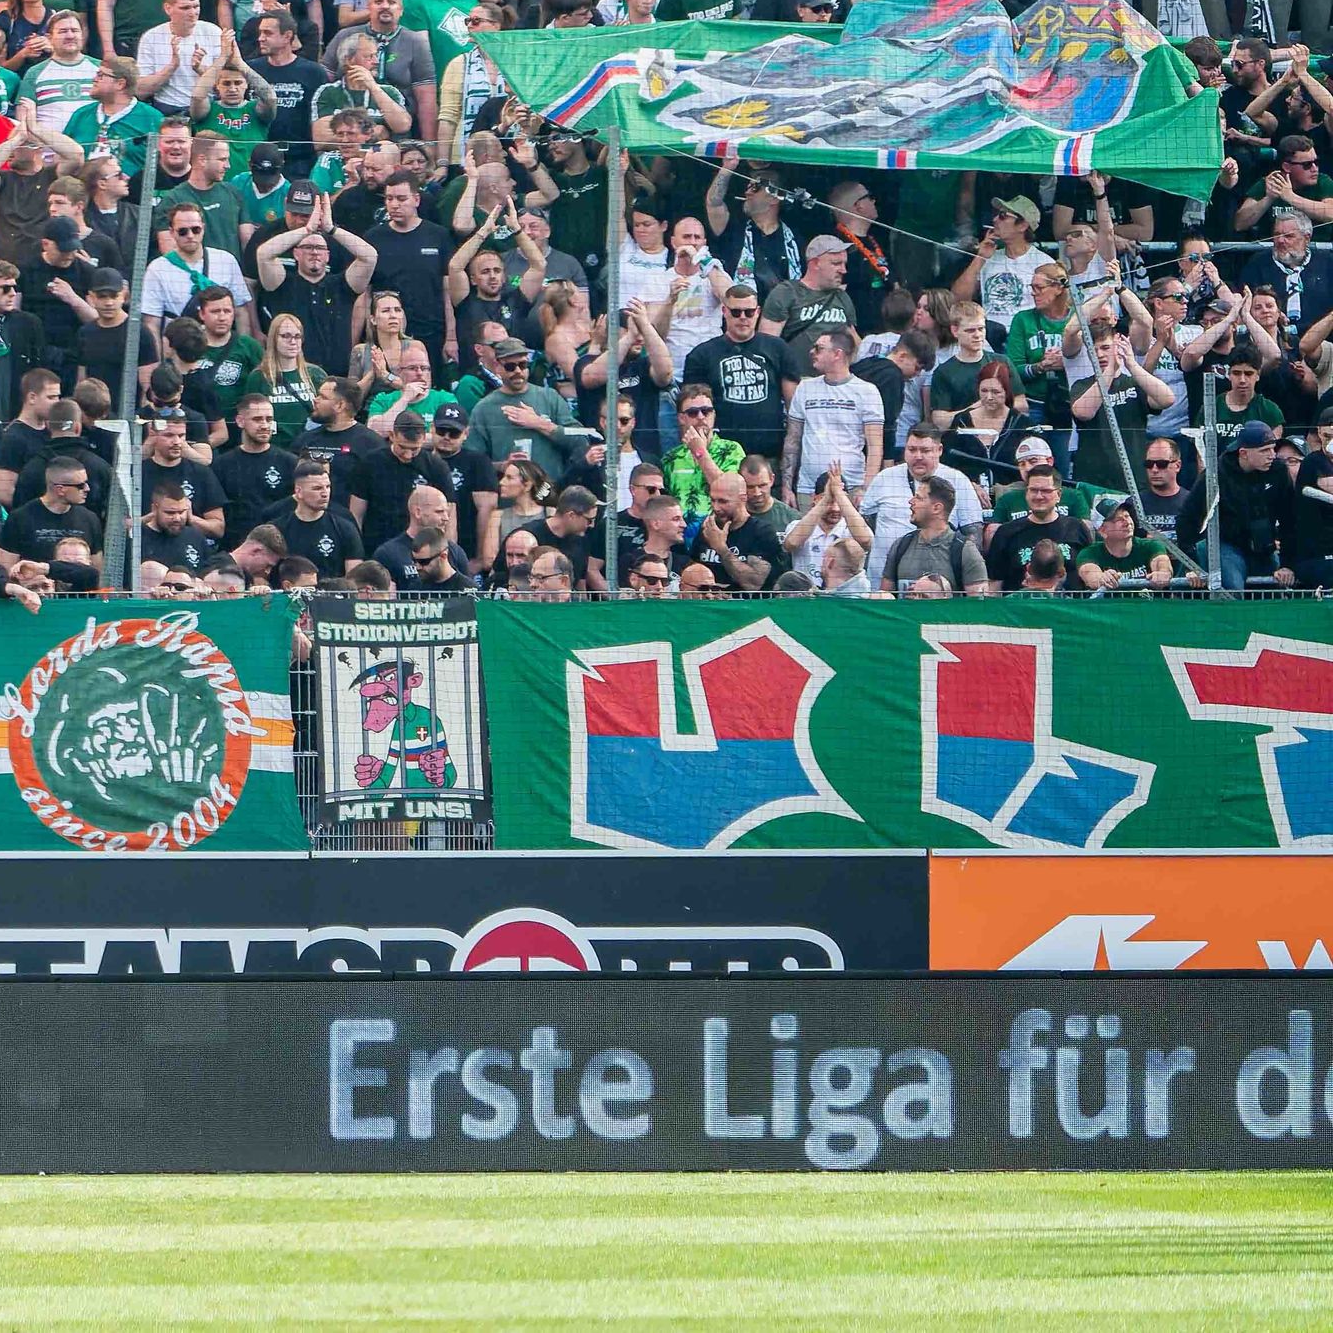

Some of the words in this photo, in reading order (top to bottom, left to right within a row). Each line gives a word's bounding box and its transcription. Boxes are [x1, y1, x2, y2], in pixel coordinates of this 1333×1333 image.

[726, 358, 743, 372] TOD
[733, 371, 757, 385] HASS
[747, 383, 766, 399] FAK
[317, 621, 479, 642] STADIONVERBOT
[21, 786, 129, 853] since
[146, 771, 236, 853] 2004
[336, 801, 396, 821] MIT
[403, 800, 474, 821] UNS!
[327, 1016, 656, 1142] Erste
[703, 1012, 956, 1171] Liga
[998, 1007, 1197, 1141] für
